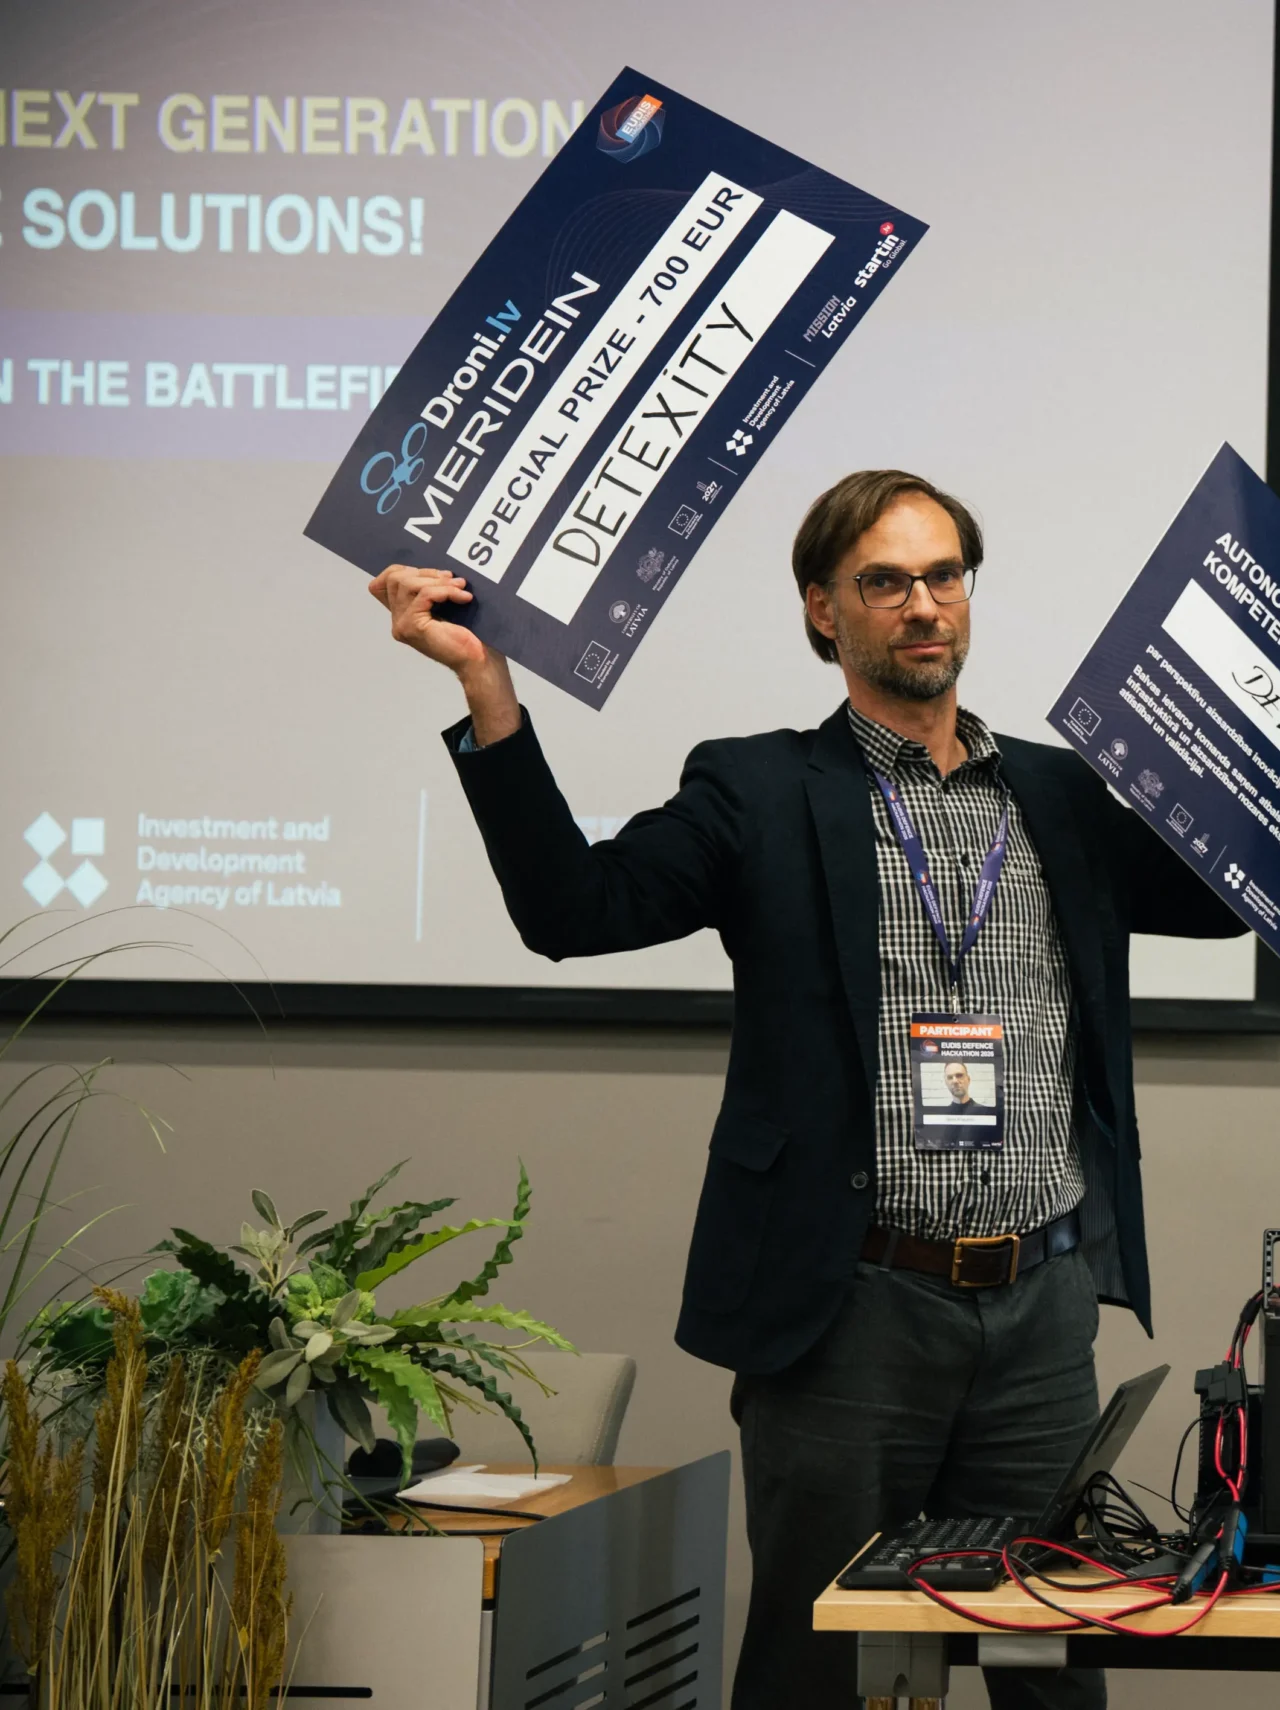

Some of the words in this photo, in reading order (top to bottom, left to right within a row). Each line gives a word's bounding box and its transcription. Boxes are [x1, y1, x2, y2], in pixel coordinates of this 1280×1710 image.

[0, 90, 139, 150] EXT
[158, 94, 585, 159] GENERATION
[622, 101, 650, 135] EUDIS
[22, 188, 424, 255] SOLUTIONS!
[854, 230, 898, 287] startin
[882, 259, 891, 268] Go
[803, 295, 840, 341] MISSION
[821, 296, 856, 337] Latvia
[27, 359, 129, 406] THE
[145, 362, 401, 410] BATTLEFI
[421, 301, 520, 427] Droni.lv
[468, 433, 567, 565] SPECIAL
[558, 328, 635, 421] PRIZE
[639, 256, 688, 305] 700
[682, 187, 742, 251] EUR
[405, 273, 598, 540] MERIDEIN
[742, 388, 770, 423] Investment
[768, 375, 779, 388] and
[748, 385, 781, 426] Development
[756, 405, 775, 430] Agency
[773, 397, 780, 406] of
[777, 380, 794, 399] Latvia
[702, 481, 717, 501] 2027
[626, 608, 648, 637] LATVIA
[1145, 644, 1162, 660] par
[1159, 659, 1206, 707] perspektīvu
[1205, 706, 1252, 755] aizsardzības
[1126, 675, 1179, 732] infrastruktūrā
[1178, 731, 1190, 745] un
[1190, 744, 1237, 793] aizsardzības
[1237, 792, 1268, 825] nozares
[1133, 664, 1160, 696] Balvas
[1161, 694, 1193, 730] ietvaros
[1194, 728, 1230, 768] komanda
[1231, 768, 1257, 796] saņem
[1152, 722, 1164, 736] un
[1165, 734, 1204, 777] validācijai.
[1097, 753, 1119, 777] LATVIA
[138, 813, 278, 841] Investment
[283, 816, 330, 843] and
[1192, 838, 1207, 853] 2027
[138, 845, 306, 877] Development
[136, 879, 228, 910] Agency
[234, 881, 262, 906] of
[267, 882, 341, 908] Latvia
[1241, 892, 1260, 911] Agency
[1263, 913, 1277, 930] Latvia
[1245, 885, 1274, 917] Development
[1248, 879, 1273, 907] Investment
[919, 1025, 993, 1036] PARTICIPANT
